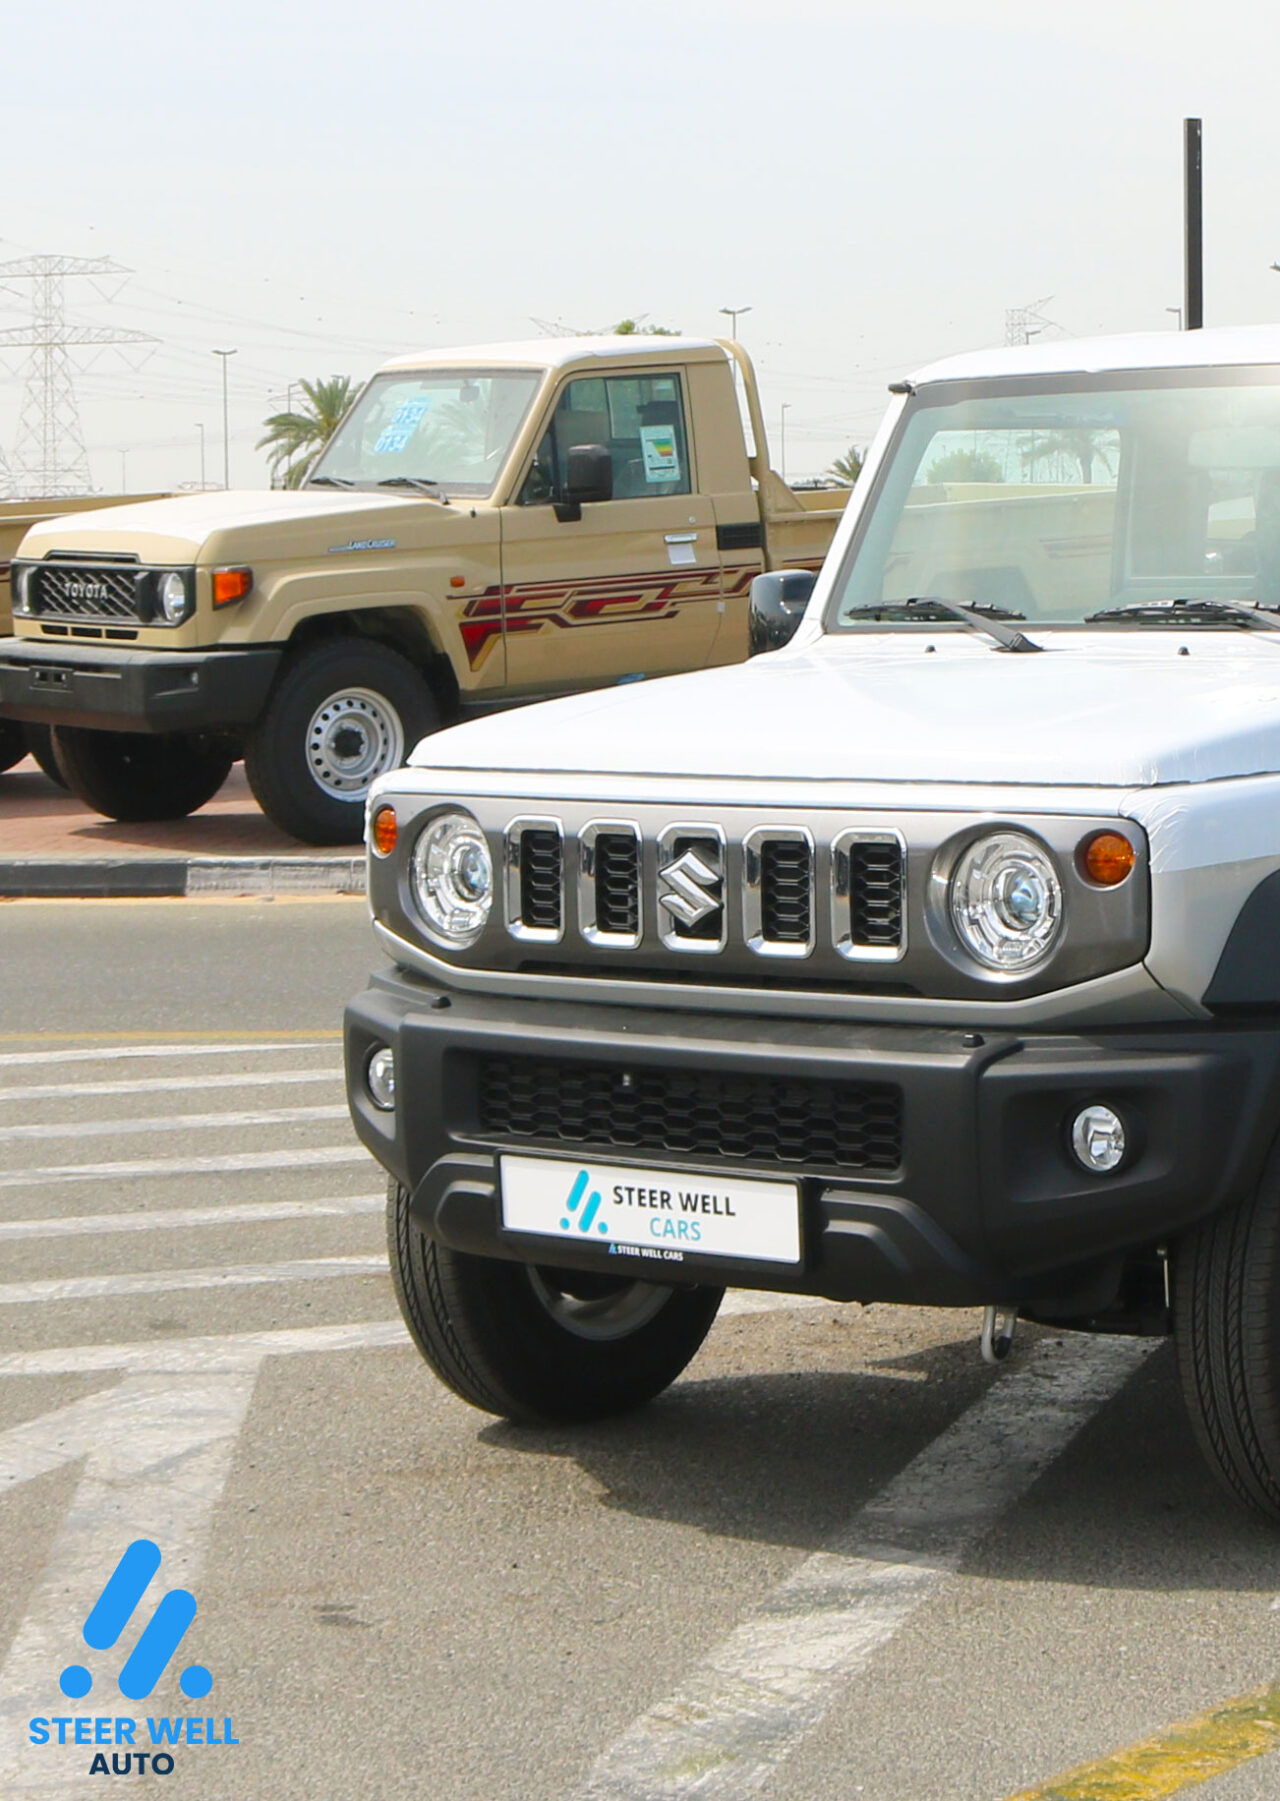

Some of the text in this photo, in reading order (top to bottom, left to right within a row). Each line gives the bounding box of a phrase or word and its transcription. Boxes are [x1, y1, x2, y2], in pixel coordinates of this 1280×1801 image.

[65, 582, 108, 600] TOYOTA
[612, 1185, 736, 1217] STEER WELL
[650, 1217, 701, 1241] CARS
[617, 1244, 684, 1261] STEER WELL CARS
